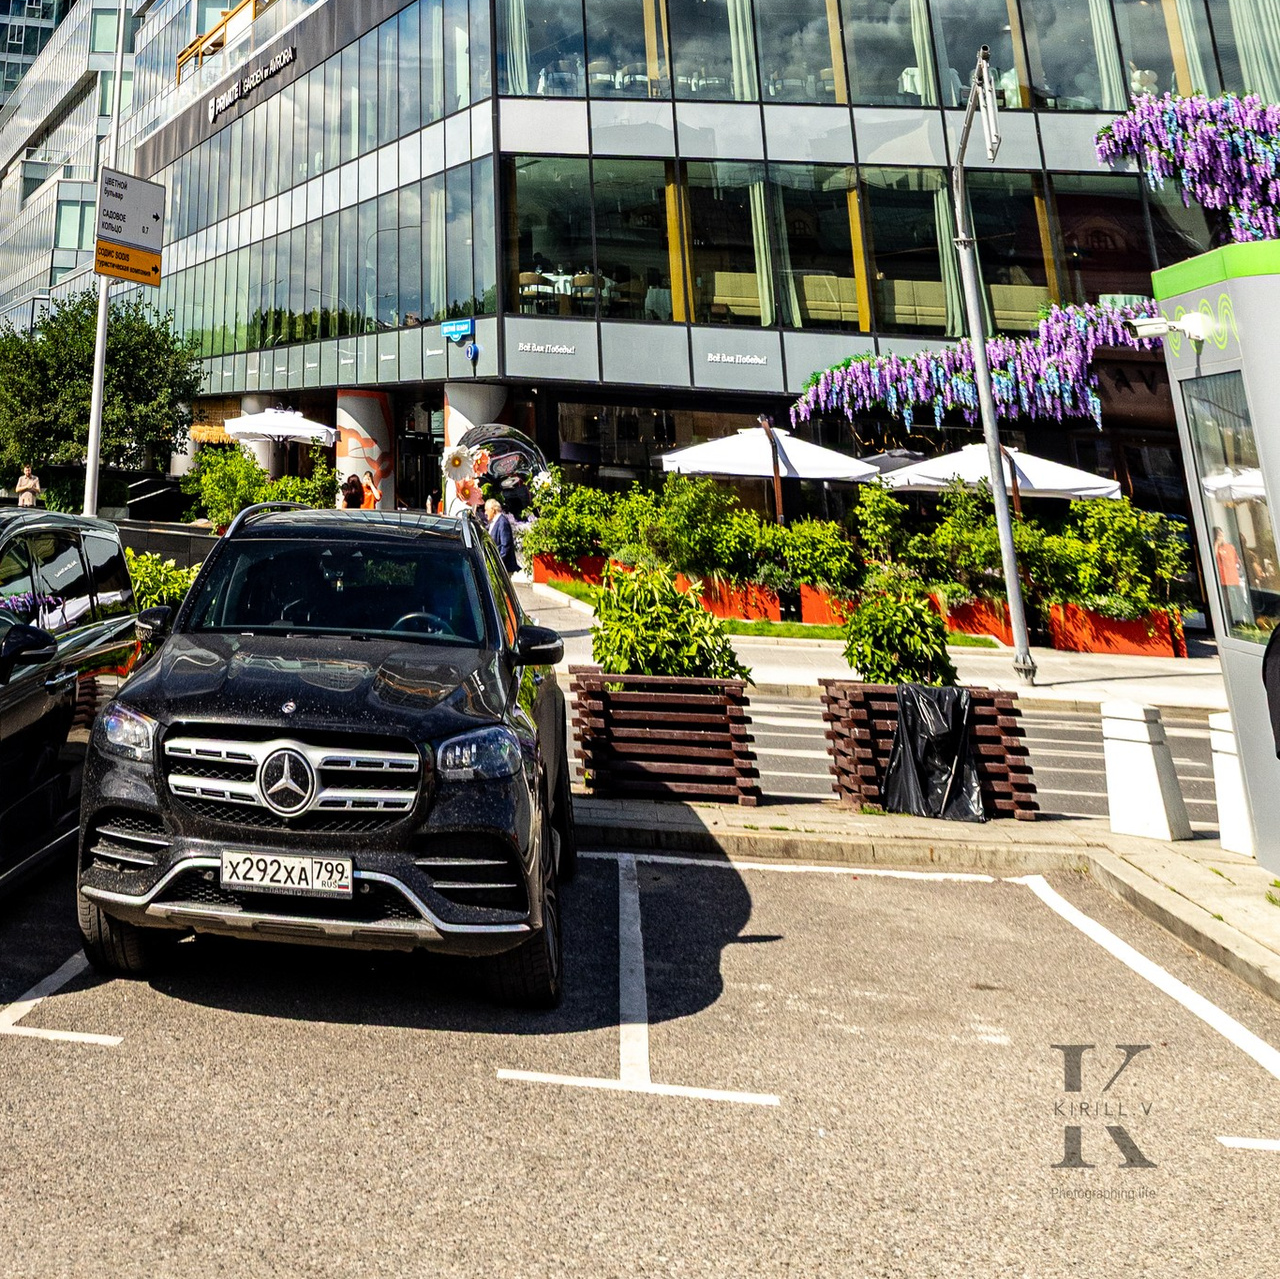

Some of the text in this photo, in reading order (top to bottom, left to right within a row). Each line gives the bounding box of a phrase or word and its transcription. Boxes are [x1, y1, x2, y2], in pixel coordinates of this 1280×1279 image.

[242, 66, 264, 93] GARDEN
[269, 46, 294, 74] AVRORA
[105, 176, 128, 190] ЦВЕТНОЙ
[104, 186, 124, 201] бульвар
[102, 208, 126, 223] САДОВОЕ
[101, 221, 122, 234] КОЛЬЦО
[97, 259, 129, 272] туристическая
[314, 861, 345, 882] 799
[321, 880, 338, 889] RUS
